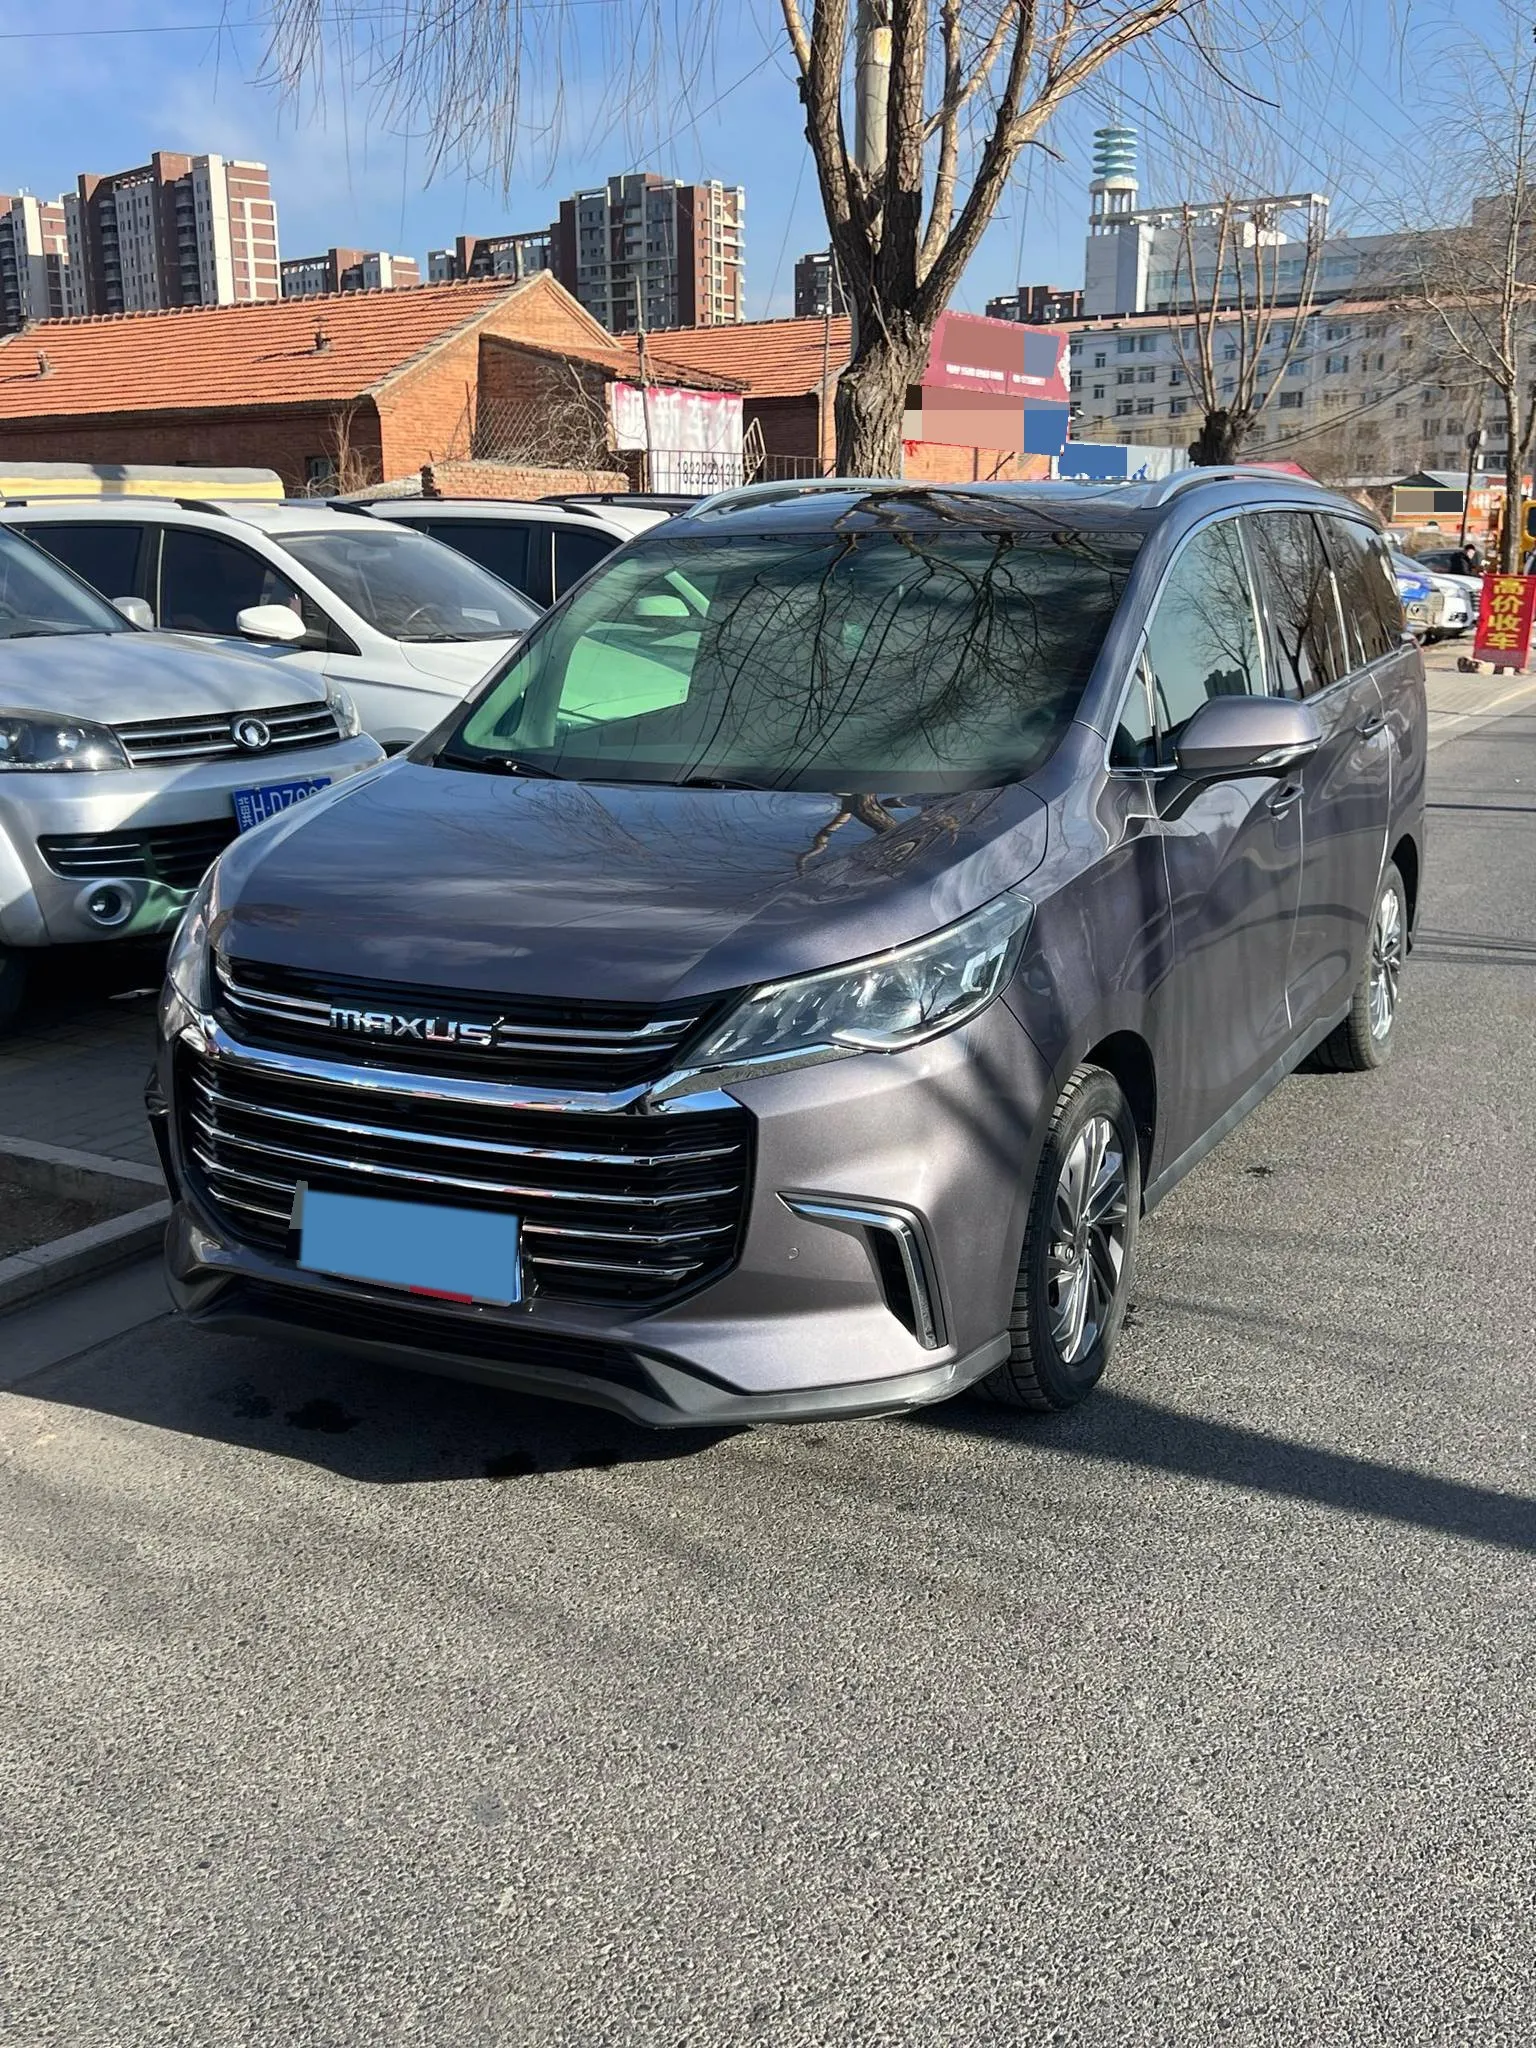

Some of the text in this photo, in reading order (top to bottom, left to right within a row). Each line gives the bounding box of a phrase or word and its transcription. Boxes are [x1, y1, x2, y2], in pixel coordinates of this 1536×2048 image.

[1484, 577, 1528, 650] 高价收车
[330, 1007, 494, 1047] MAXUS
